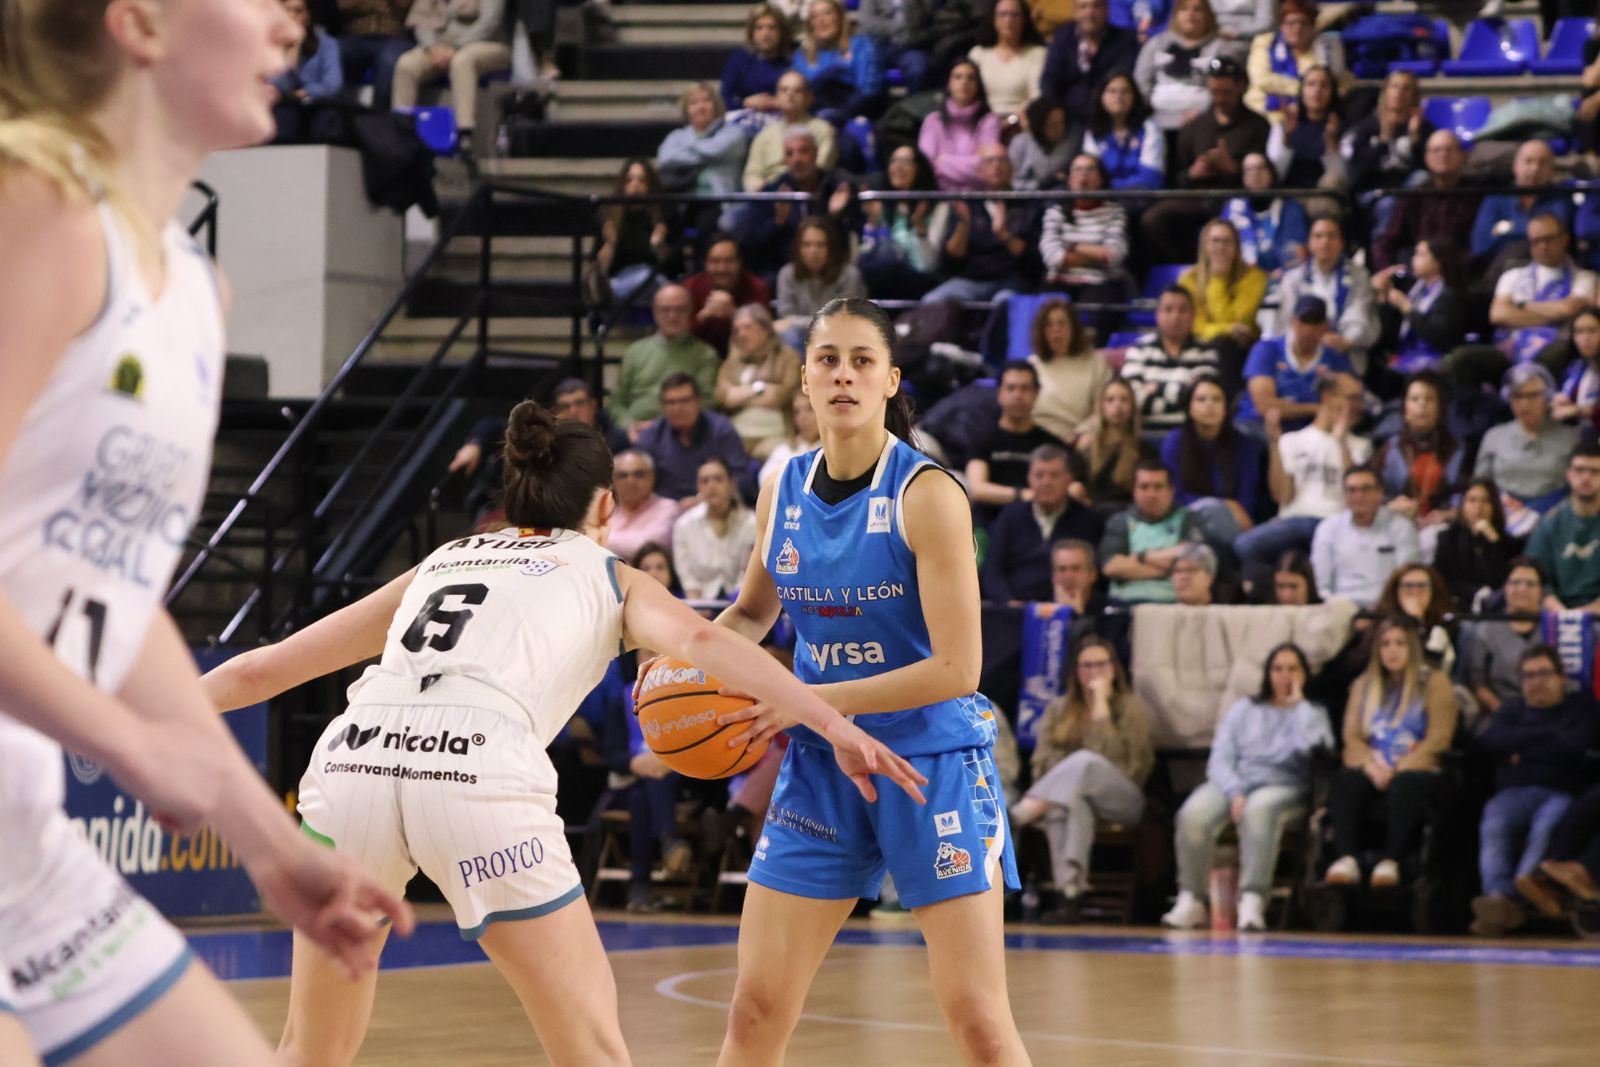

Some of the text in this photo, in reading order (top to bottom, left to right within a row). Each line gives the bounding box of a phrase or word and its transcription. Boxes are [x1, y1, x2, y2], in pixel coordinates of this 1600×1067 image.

[424, 557, 530, 575] Alcantarilla
[776, 580, 904, 604] CASTILLA Y LEÓN
[400, 583, 490, 653] 6
[324, 761, 478, 785] ConservandMomentos
[458, 836, 545, 889] PROYCO
